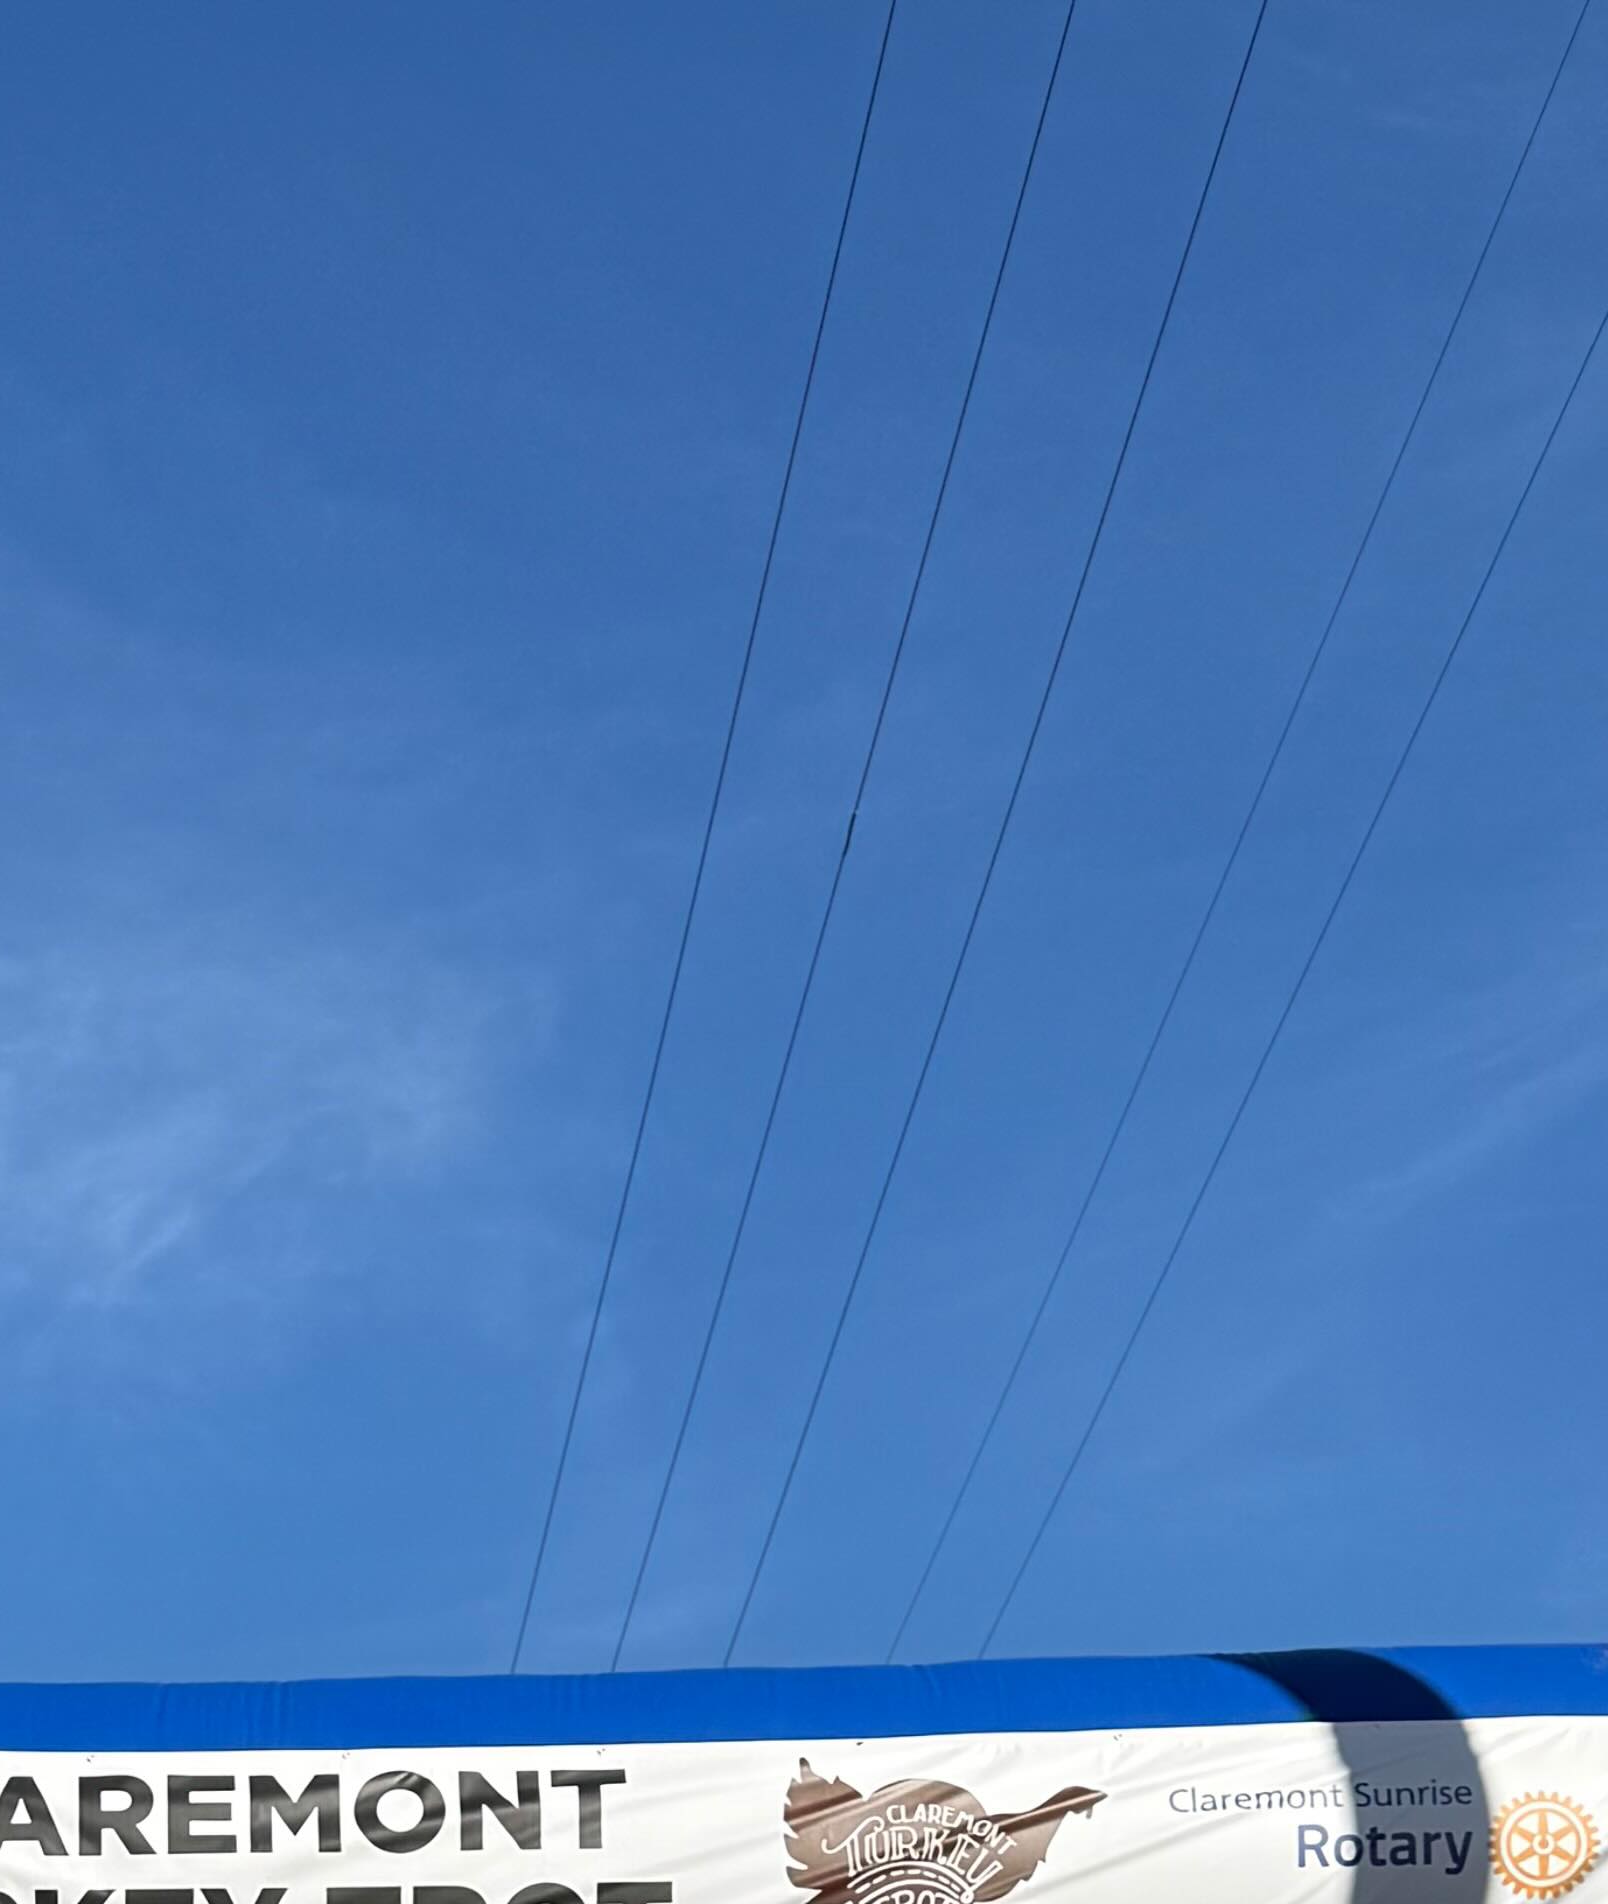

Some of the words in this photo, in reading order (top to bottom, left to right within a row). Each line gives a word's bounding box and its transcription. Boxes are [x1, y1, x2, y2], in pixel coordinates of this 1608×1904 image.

[1169, 1784, 1343, 1814] Claremont
[1355, 1782, 1473, 1808] Sunrise
[887, 1804, 1017, 1855] CLAREMONT
[1298, 1822, 1473, 1875] Rotary
[821, 1816, 1003, 1904] TURKEY
